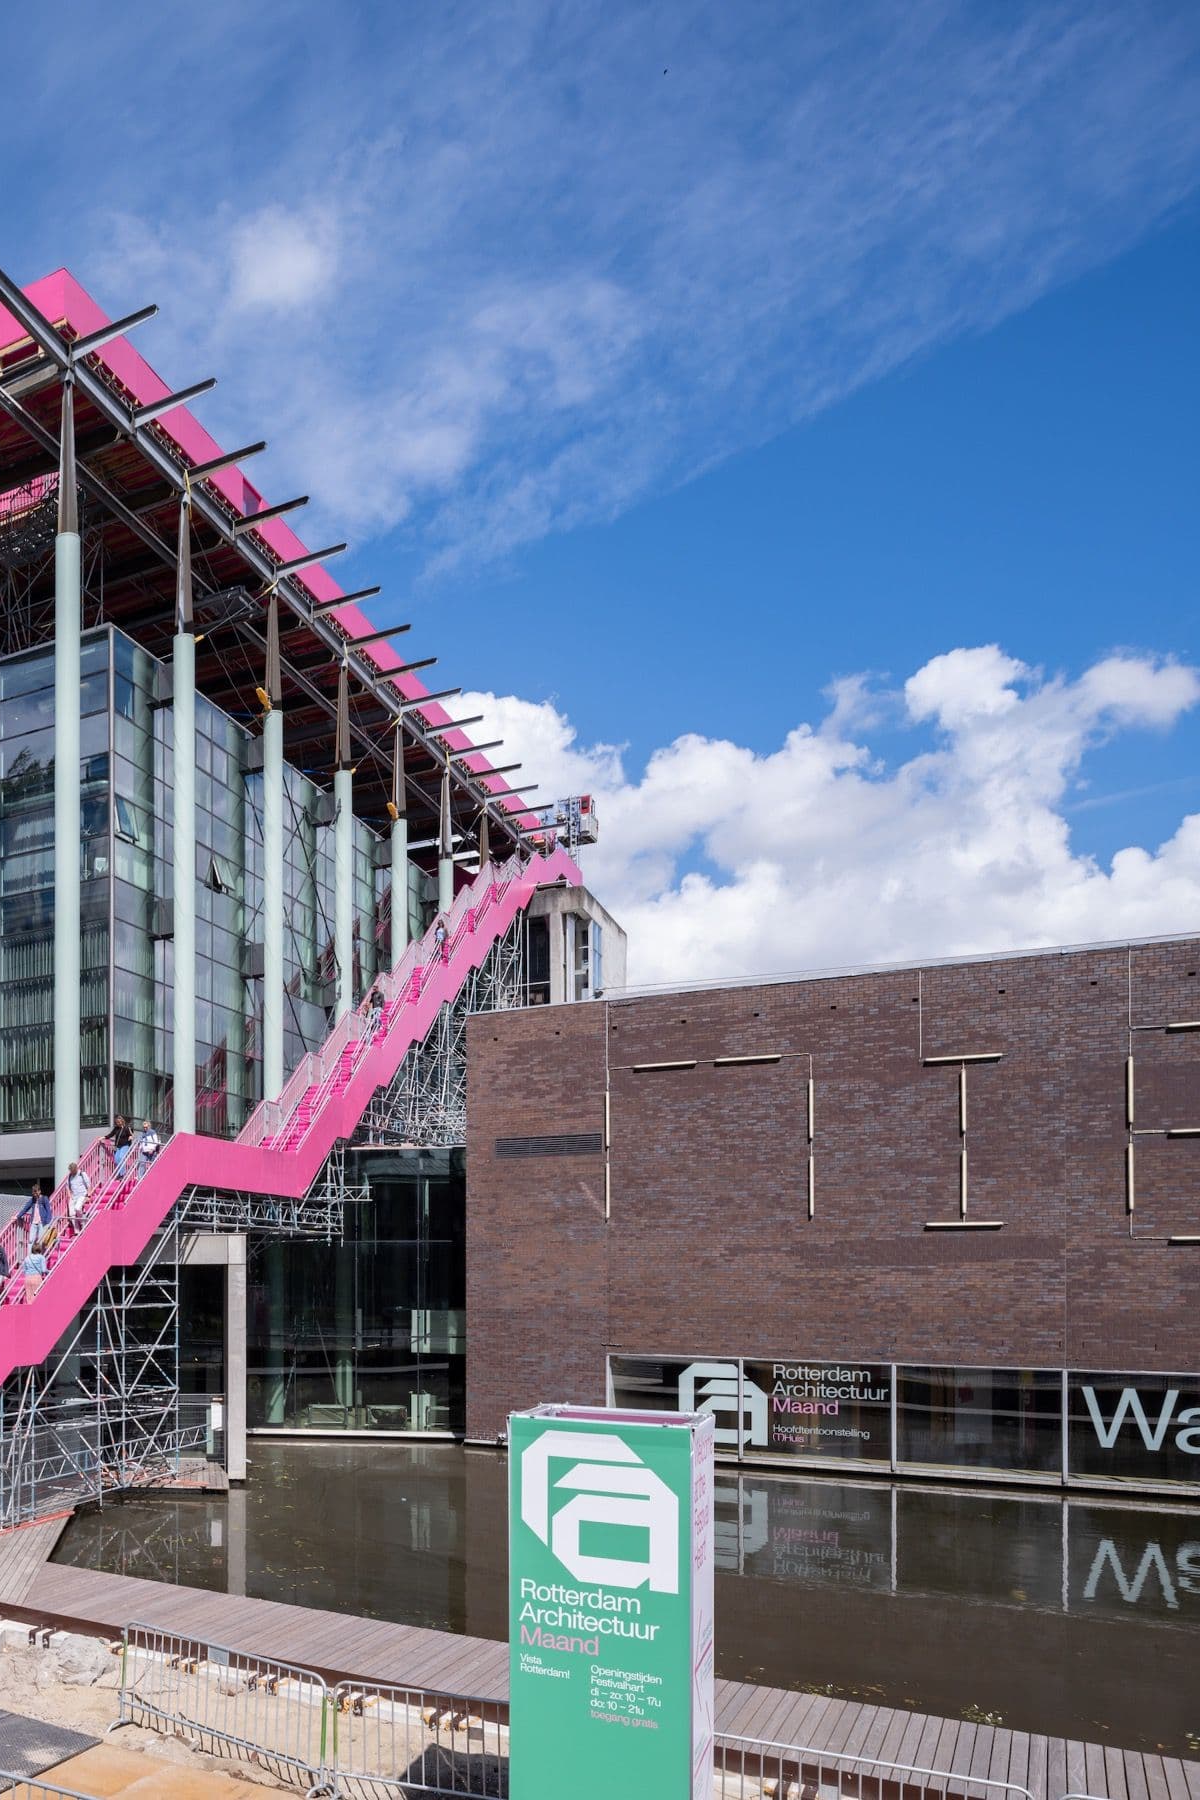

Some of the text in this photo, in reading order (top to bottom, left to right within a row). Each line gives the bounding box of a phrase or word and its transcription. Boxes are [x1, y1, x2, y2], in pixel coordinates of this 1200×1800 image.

[773, 1364, 871, 1383] Rotterdam
[772, 1382, 889, 1401] Architectuur
[773, 1398, 839, 1416] Maand
[773, 1424, 871, 1440] Hoofdtentoonstelling
[519, 1578, 641, 1615] Rotterdam
[519, 1603, 660, 1641] Architectuur
[519, 1625, 600, 1656] Maand
[520, 1653, 542, 1665] Vista
[520, 1663, 571, 1679] Rotterdam!
[590, 1664, 663, 1685] Openingstijden
[591, 1676, 645, 1693] Festivalhart
[591, 1687, 599, 1696] di
[625, 1692, 636, 1703] 10
[647, 1696, 662, 1707] 17u
[607, 1701, 618, 1711] 10
[628, 1705, 645, 1716] 21u
